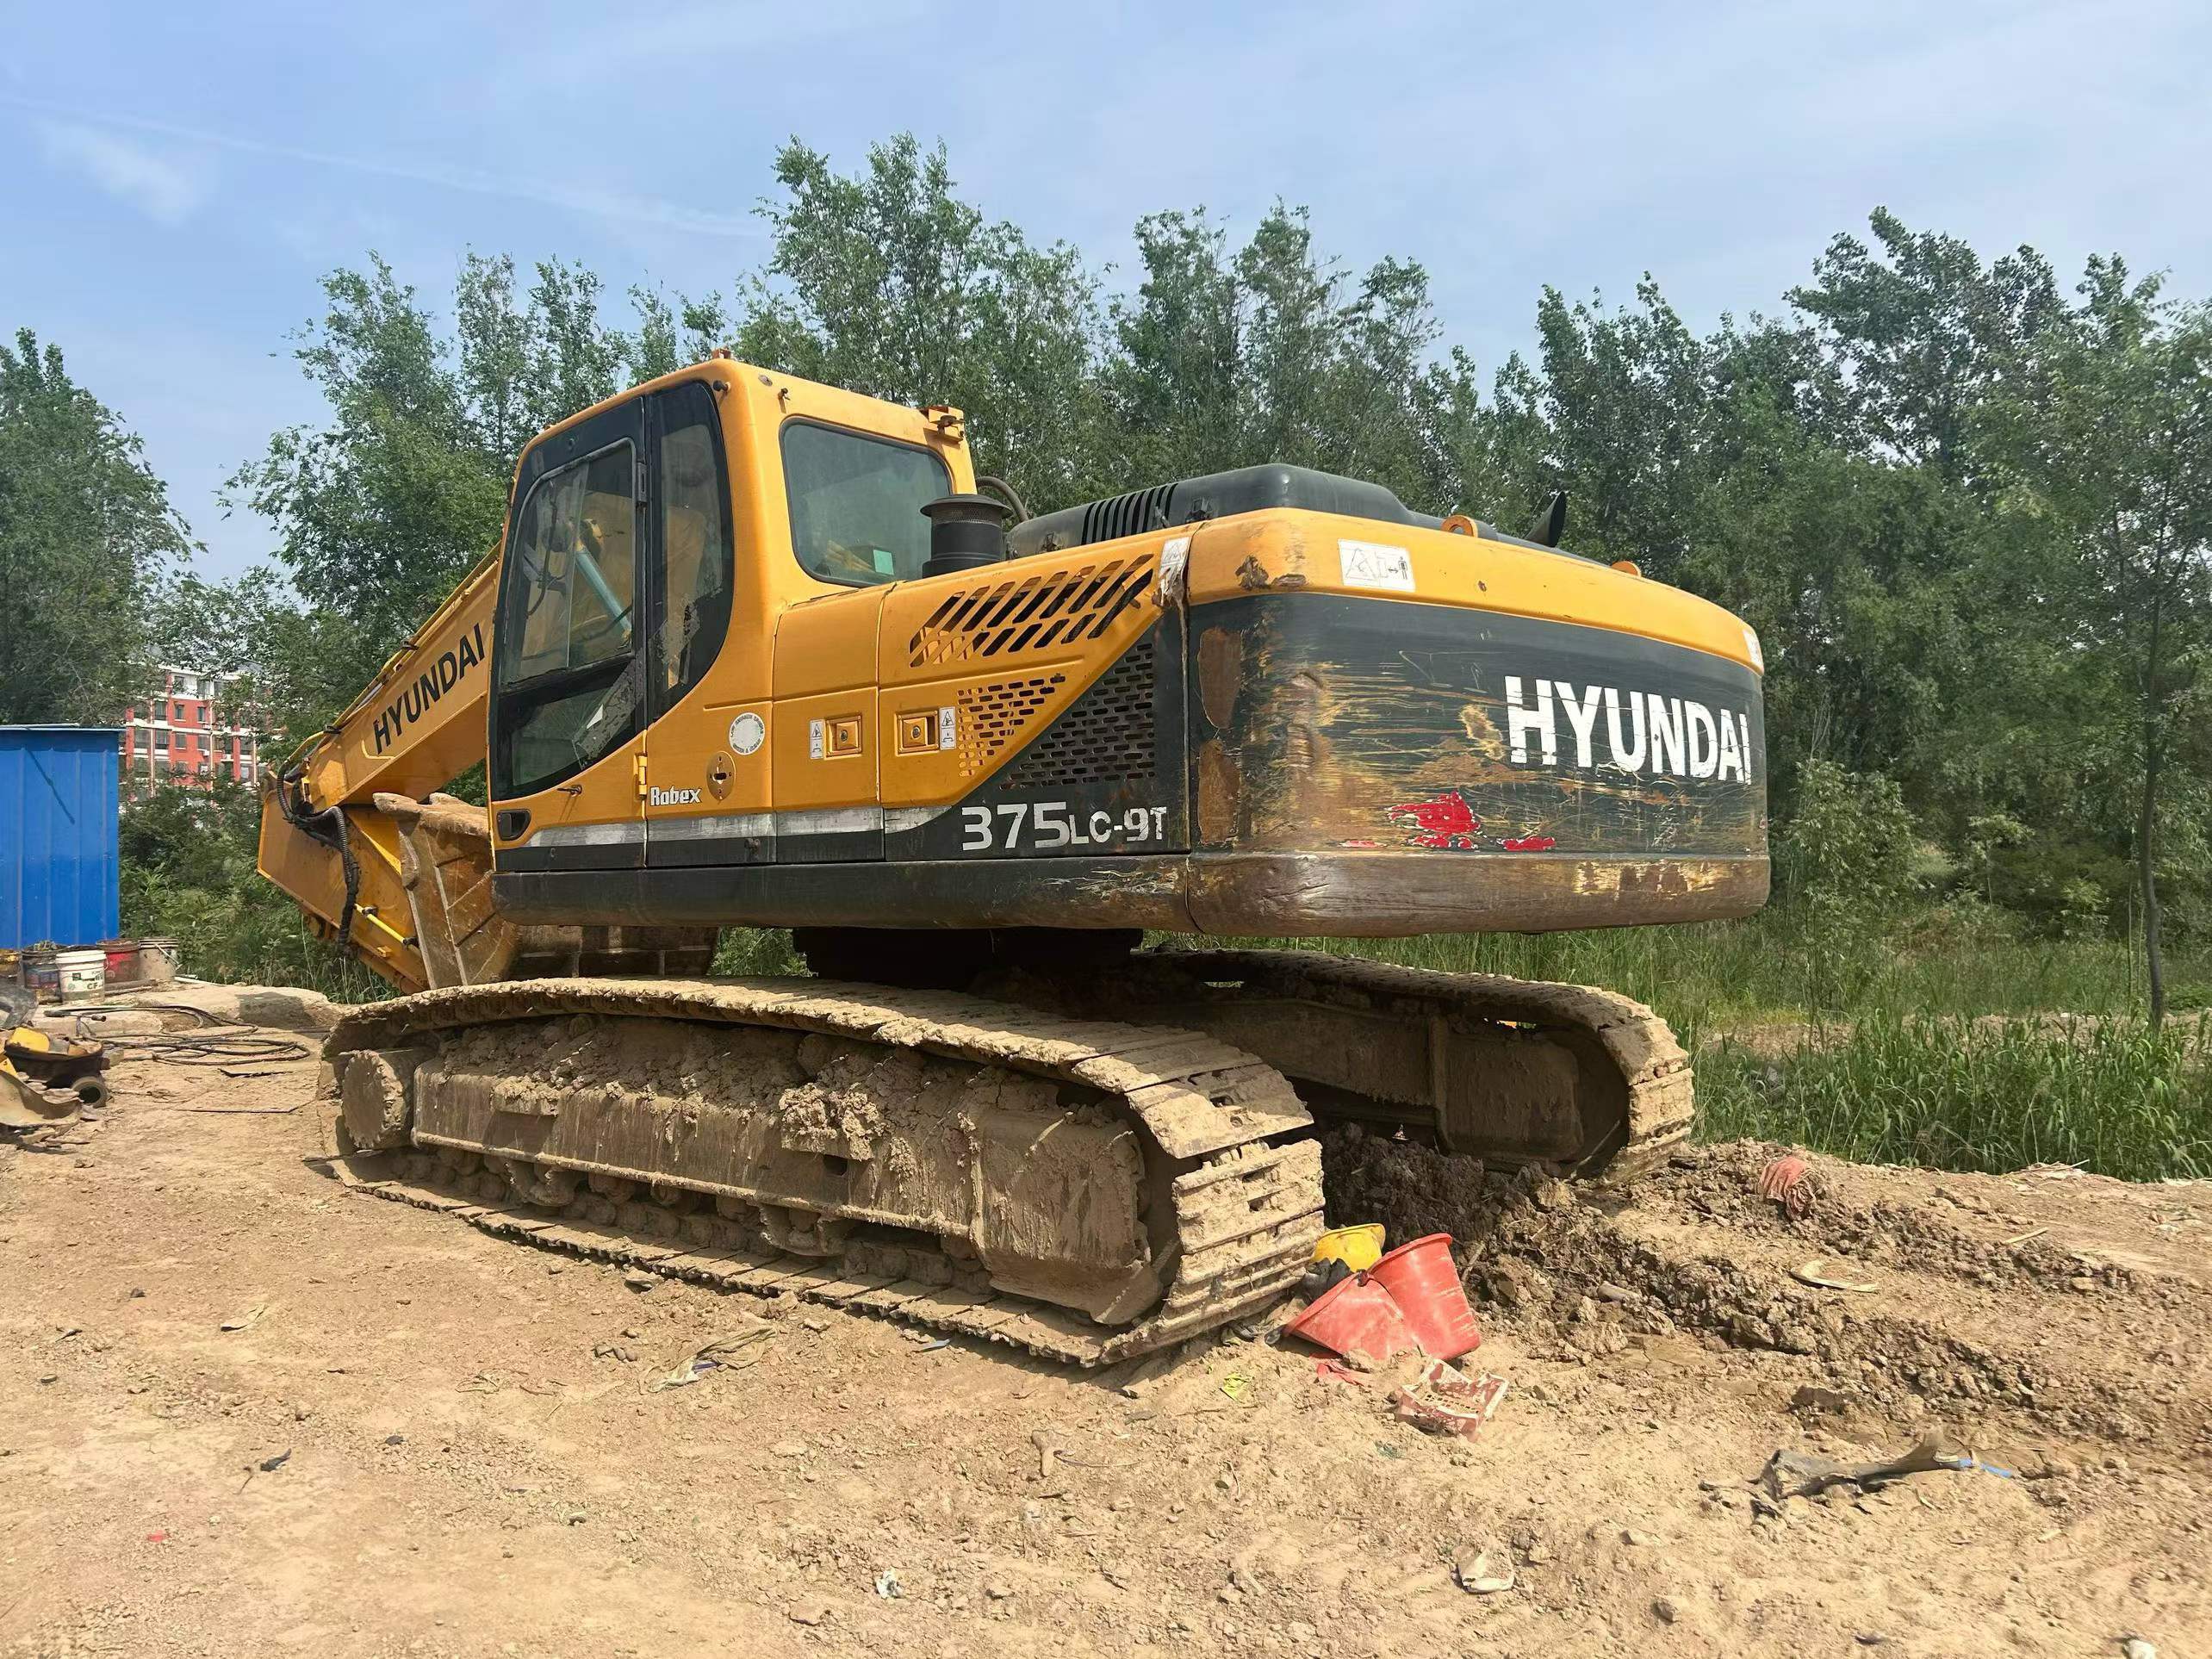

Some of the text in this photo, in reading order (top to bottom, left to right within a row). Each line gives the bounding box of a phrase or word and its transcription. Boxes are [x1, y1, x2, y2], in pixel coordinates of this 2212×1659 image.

[372, 622, 485, 755] HYUNDAI
[1505, 675, 1751, 785] HYUNDAI
[650, 785, 702, 805] Robex
